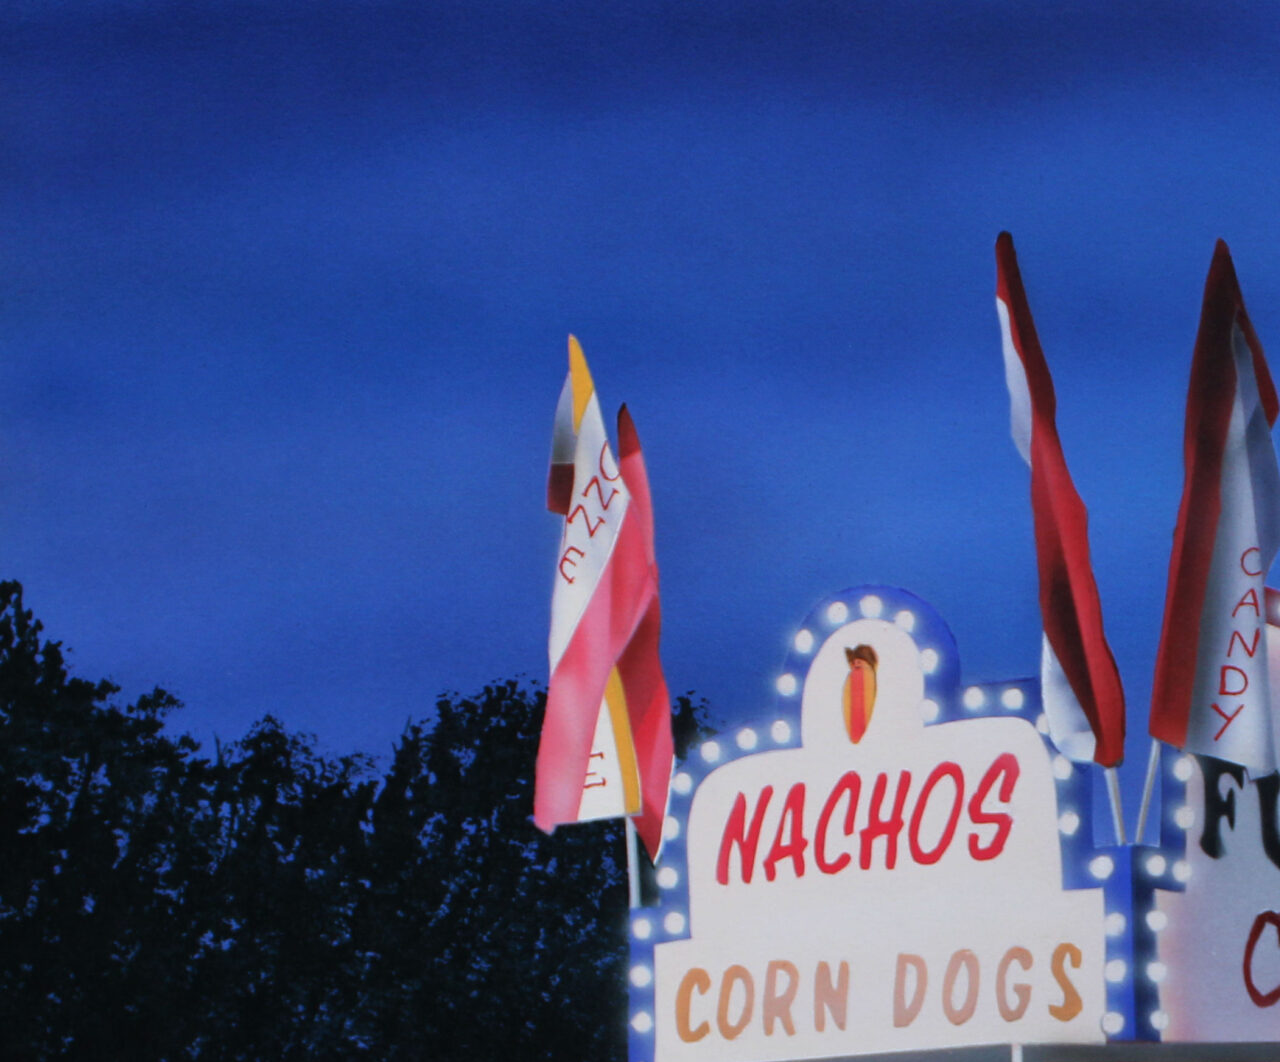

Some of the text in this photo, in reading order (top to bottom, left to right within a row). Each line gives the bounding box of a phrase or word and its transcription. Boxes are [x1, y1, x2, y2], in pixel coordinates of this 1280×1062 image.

[1211, 546, 1263, 742] CANDY
[715, 752, 1020, 886] NACHOS
[675, 942, 1083, 1044] CORN DOGS
